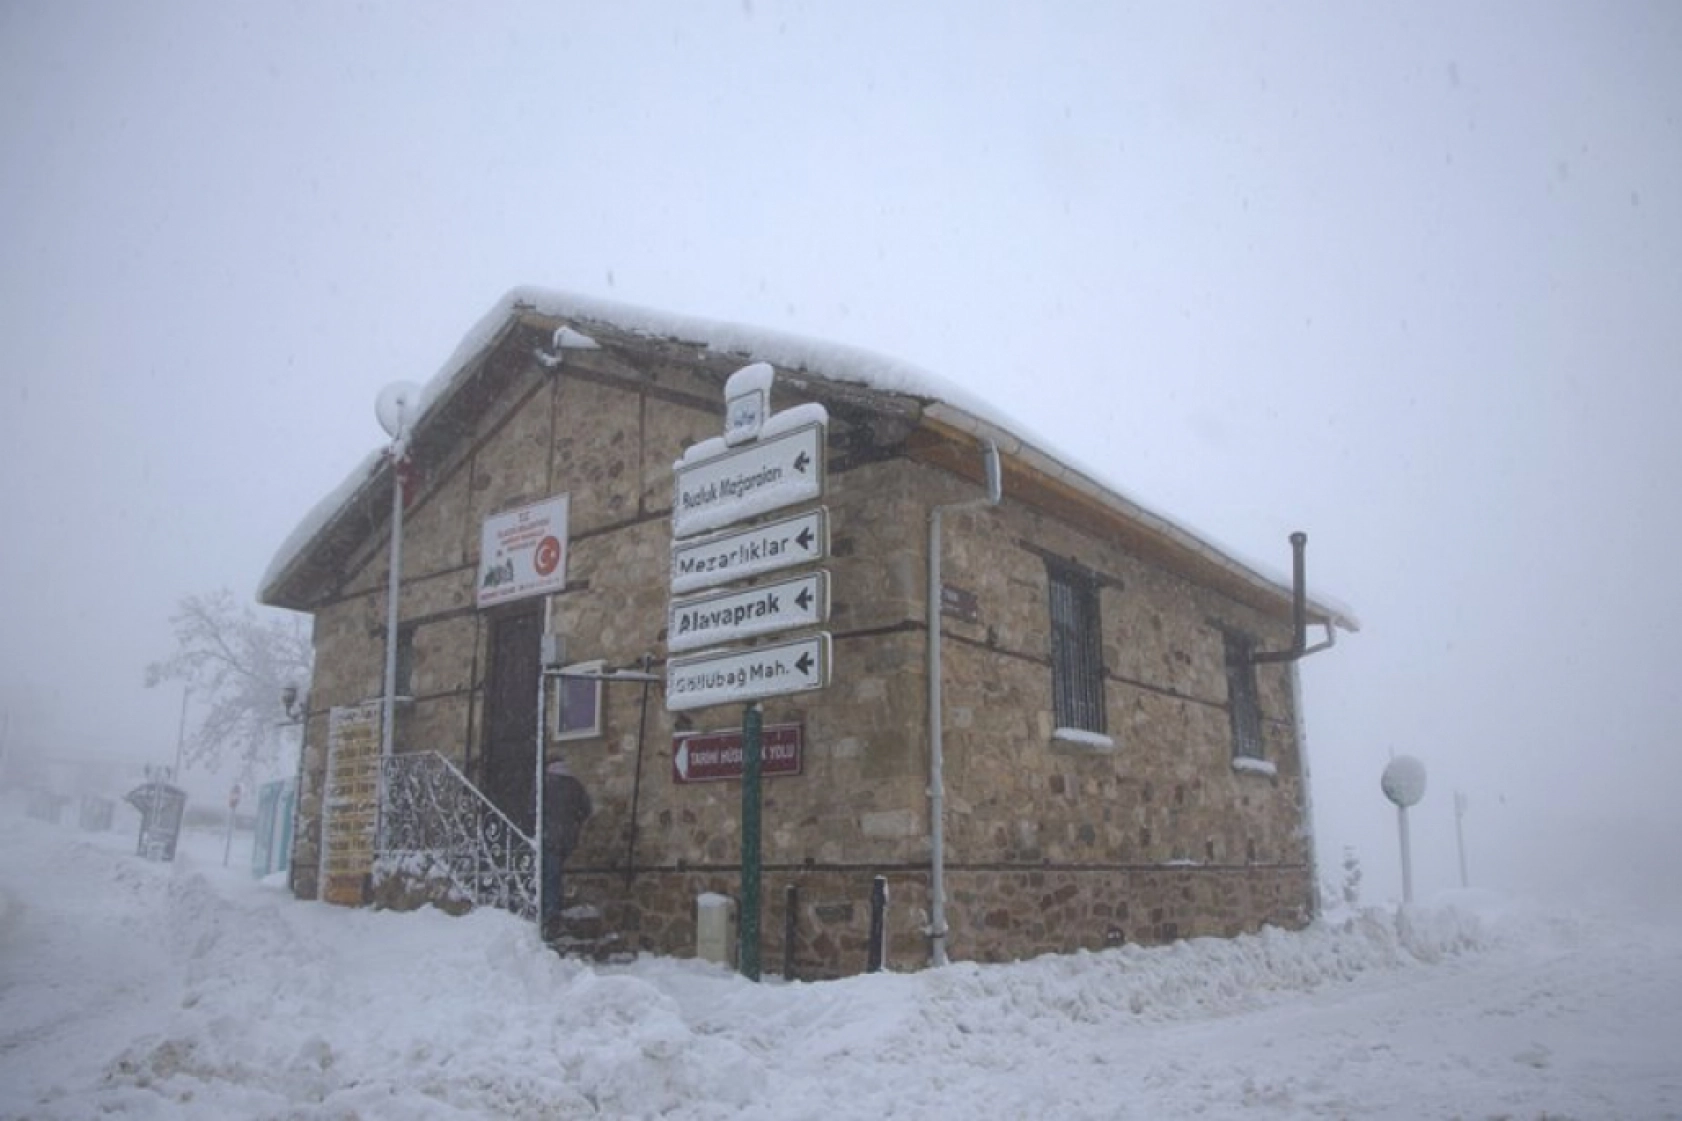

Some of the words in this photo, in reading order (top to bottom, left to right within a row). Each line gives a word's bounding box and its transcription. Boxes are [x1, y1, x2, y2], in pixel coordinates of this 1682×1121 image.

[679, 538, 789, 573] Mezarlıklar
[678, 592, 780, 635] Alavaprak
[750, 659, 790, 681] Mah.
